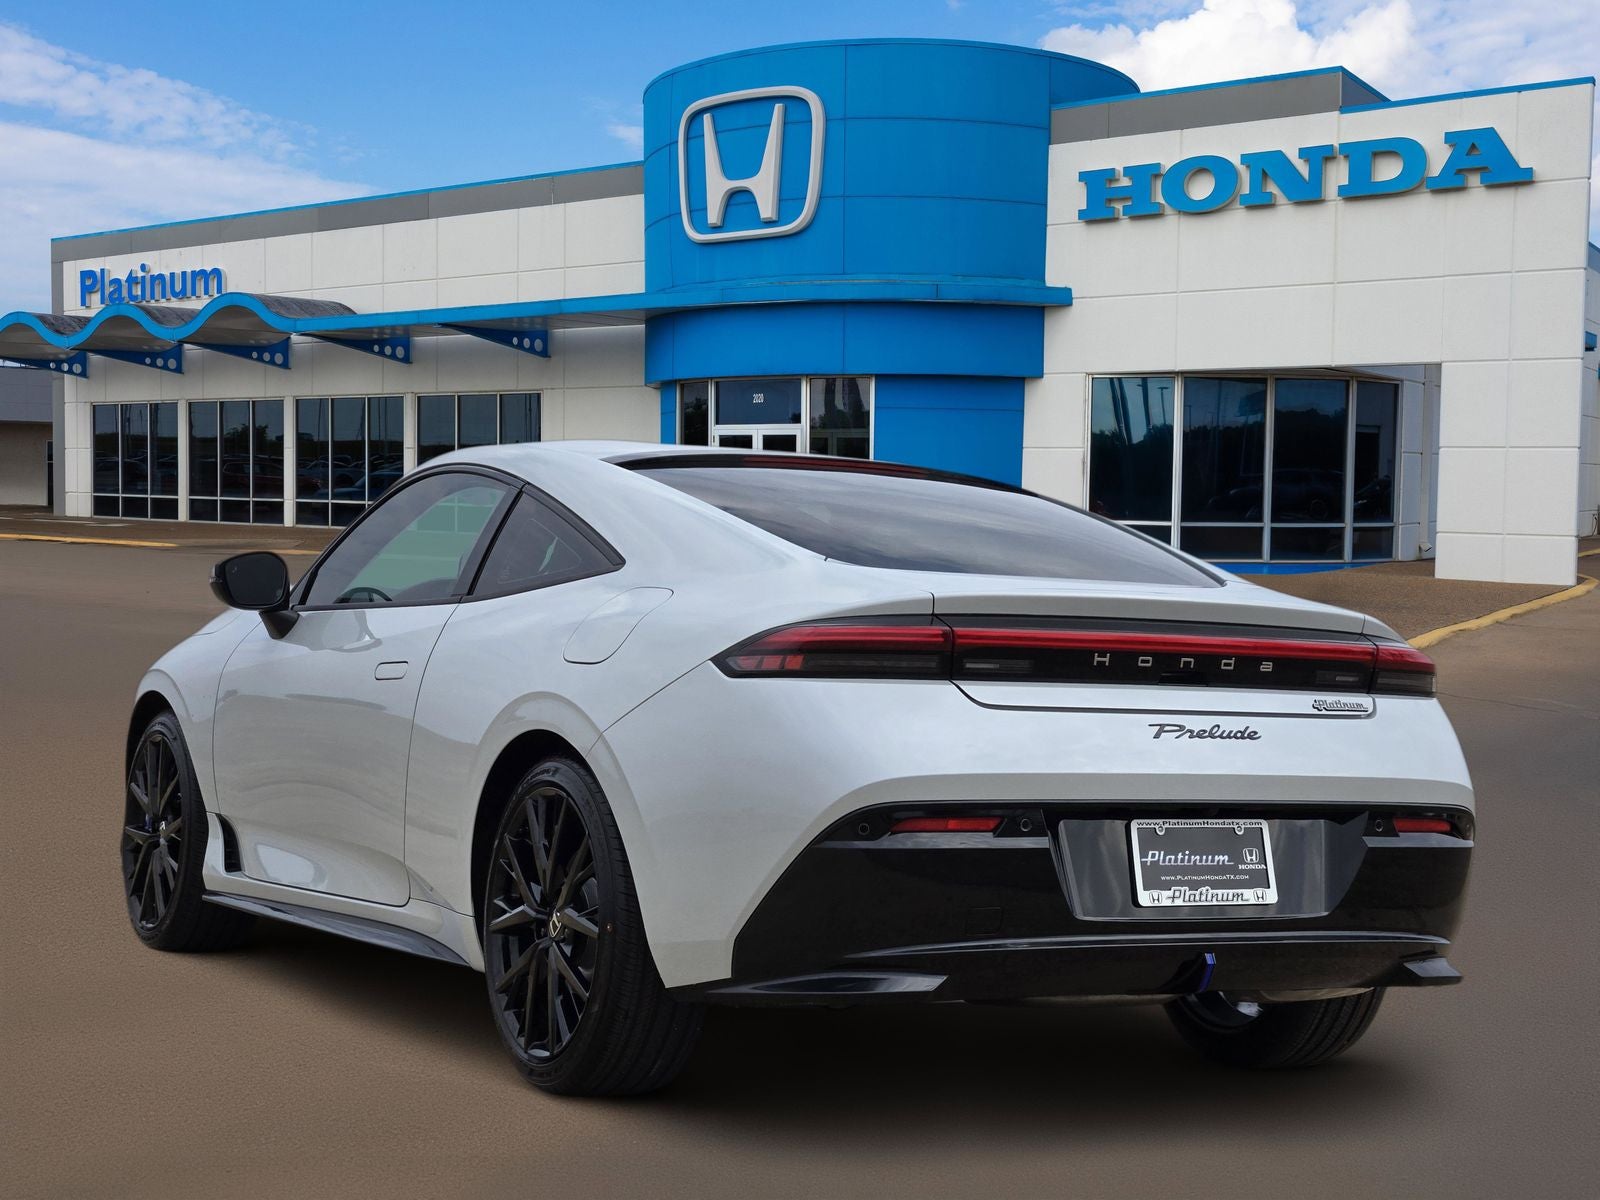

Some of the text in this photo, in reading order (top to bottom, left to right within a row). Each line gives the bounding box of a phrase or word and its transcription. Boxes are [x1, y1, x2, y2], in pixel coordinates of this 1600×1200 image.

[1078, 127, 1534, 222] HONDA
[79, 263, 226, 307] Platinum
[1093, 653, 1273, 672] Honda
[1311, 699, 1369, 712] Platinum
[1148, 723, 1262, 741] Prelude
[1141, 850, 1234, 866] Platinum
[1166, 886, 1250, 903] Platinum
